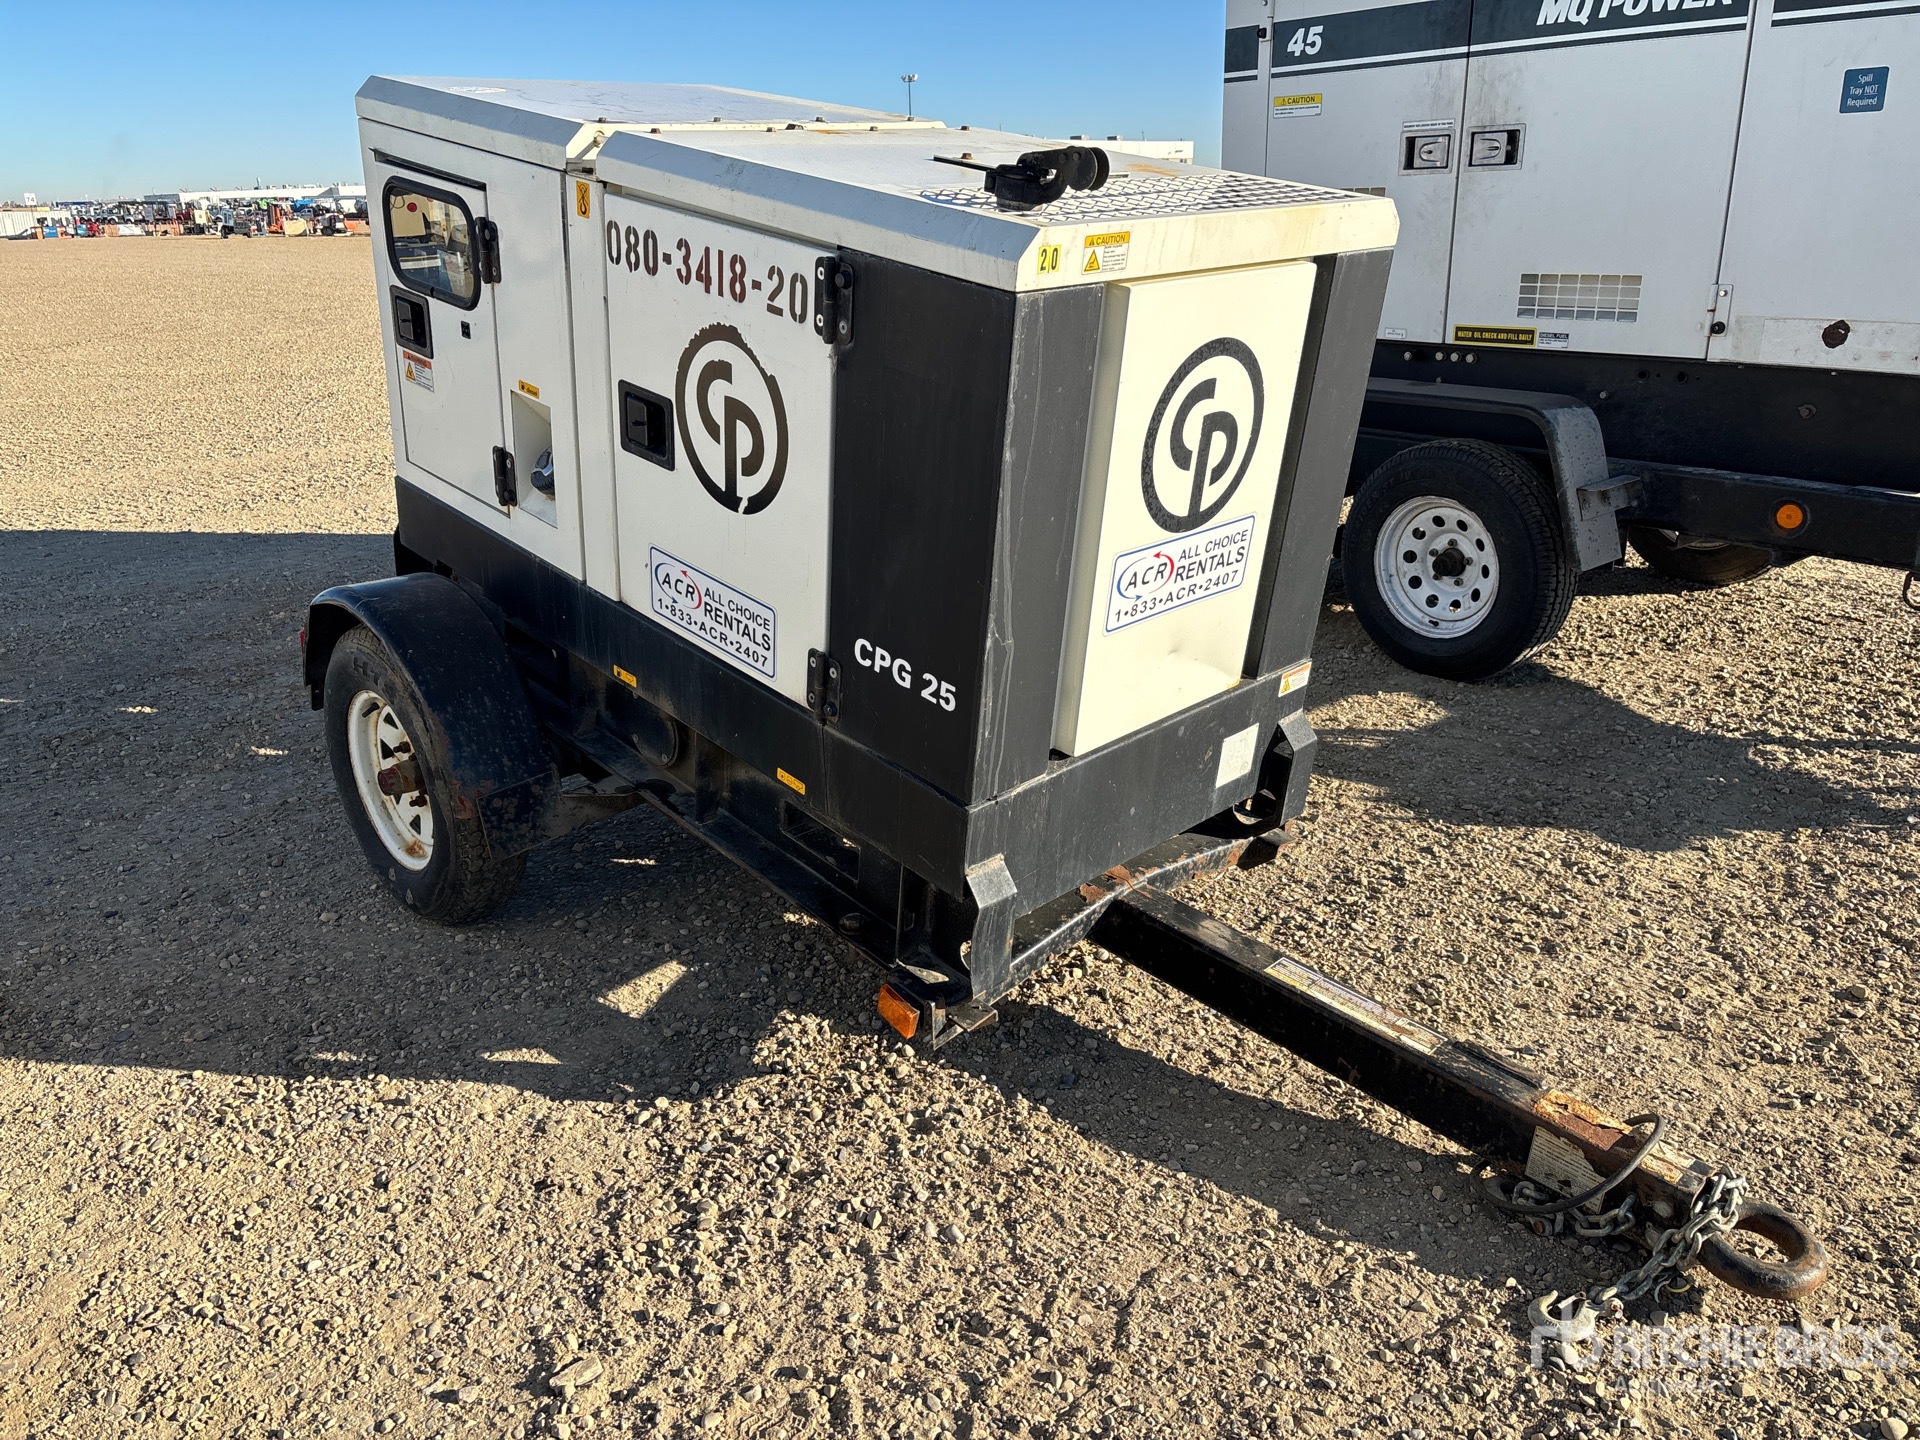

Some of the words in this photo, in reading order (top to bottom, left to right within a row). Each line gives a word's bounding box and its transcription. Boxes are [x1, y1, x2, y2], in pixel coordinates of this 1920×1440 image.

[1536, 0, 1593, 25] MQ
[1287, 25, 1324, 56] 45
[1850, 86, 1864, 97] Tray
[1864, 84, 1879, 95] NOT
[1858, 73, 1874, 85] Spill
[1287, 95, 1316, 105] CAUTION
[1847, 96, 1878, 108] Required
[1096, 234, 1126, 245] CAUTION
[606, 220, 808, 324] 080-3418-20
[1040, 247, 1059, 272] 20
[1457, 330, 1472, 338] WATER
[1497, 332, 1507, 340] AND
[1519, 333, 1532, 341] DAILY
[1178, 545, 1201, 562] ALL
[1204, 529, 1249, 553] CHOICE
[1124, 562, 1168, 592] ACR
[1174, 546, 1246, 584] RENTALS
[661, 572, 696, 602] ACR
[704, 587, 725, 607] ALL
[727, 599, 771, 632] CHOICE
[704, 601, 771, 652] RENTALS
[854, 638, 912, 690] CPG
[920, 672, 957, 712] 25
